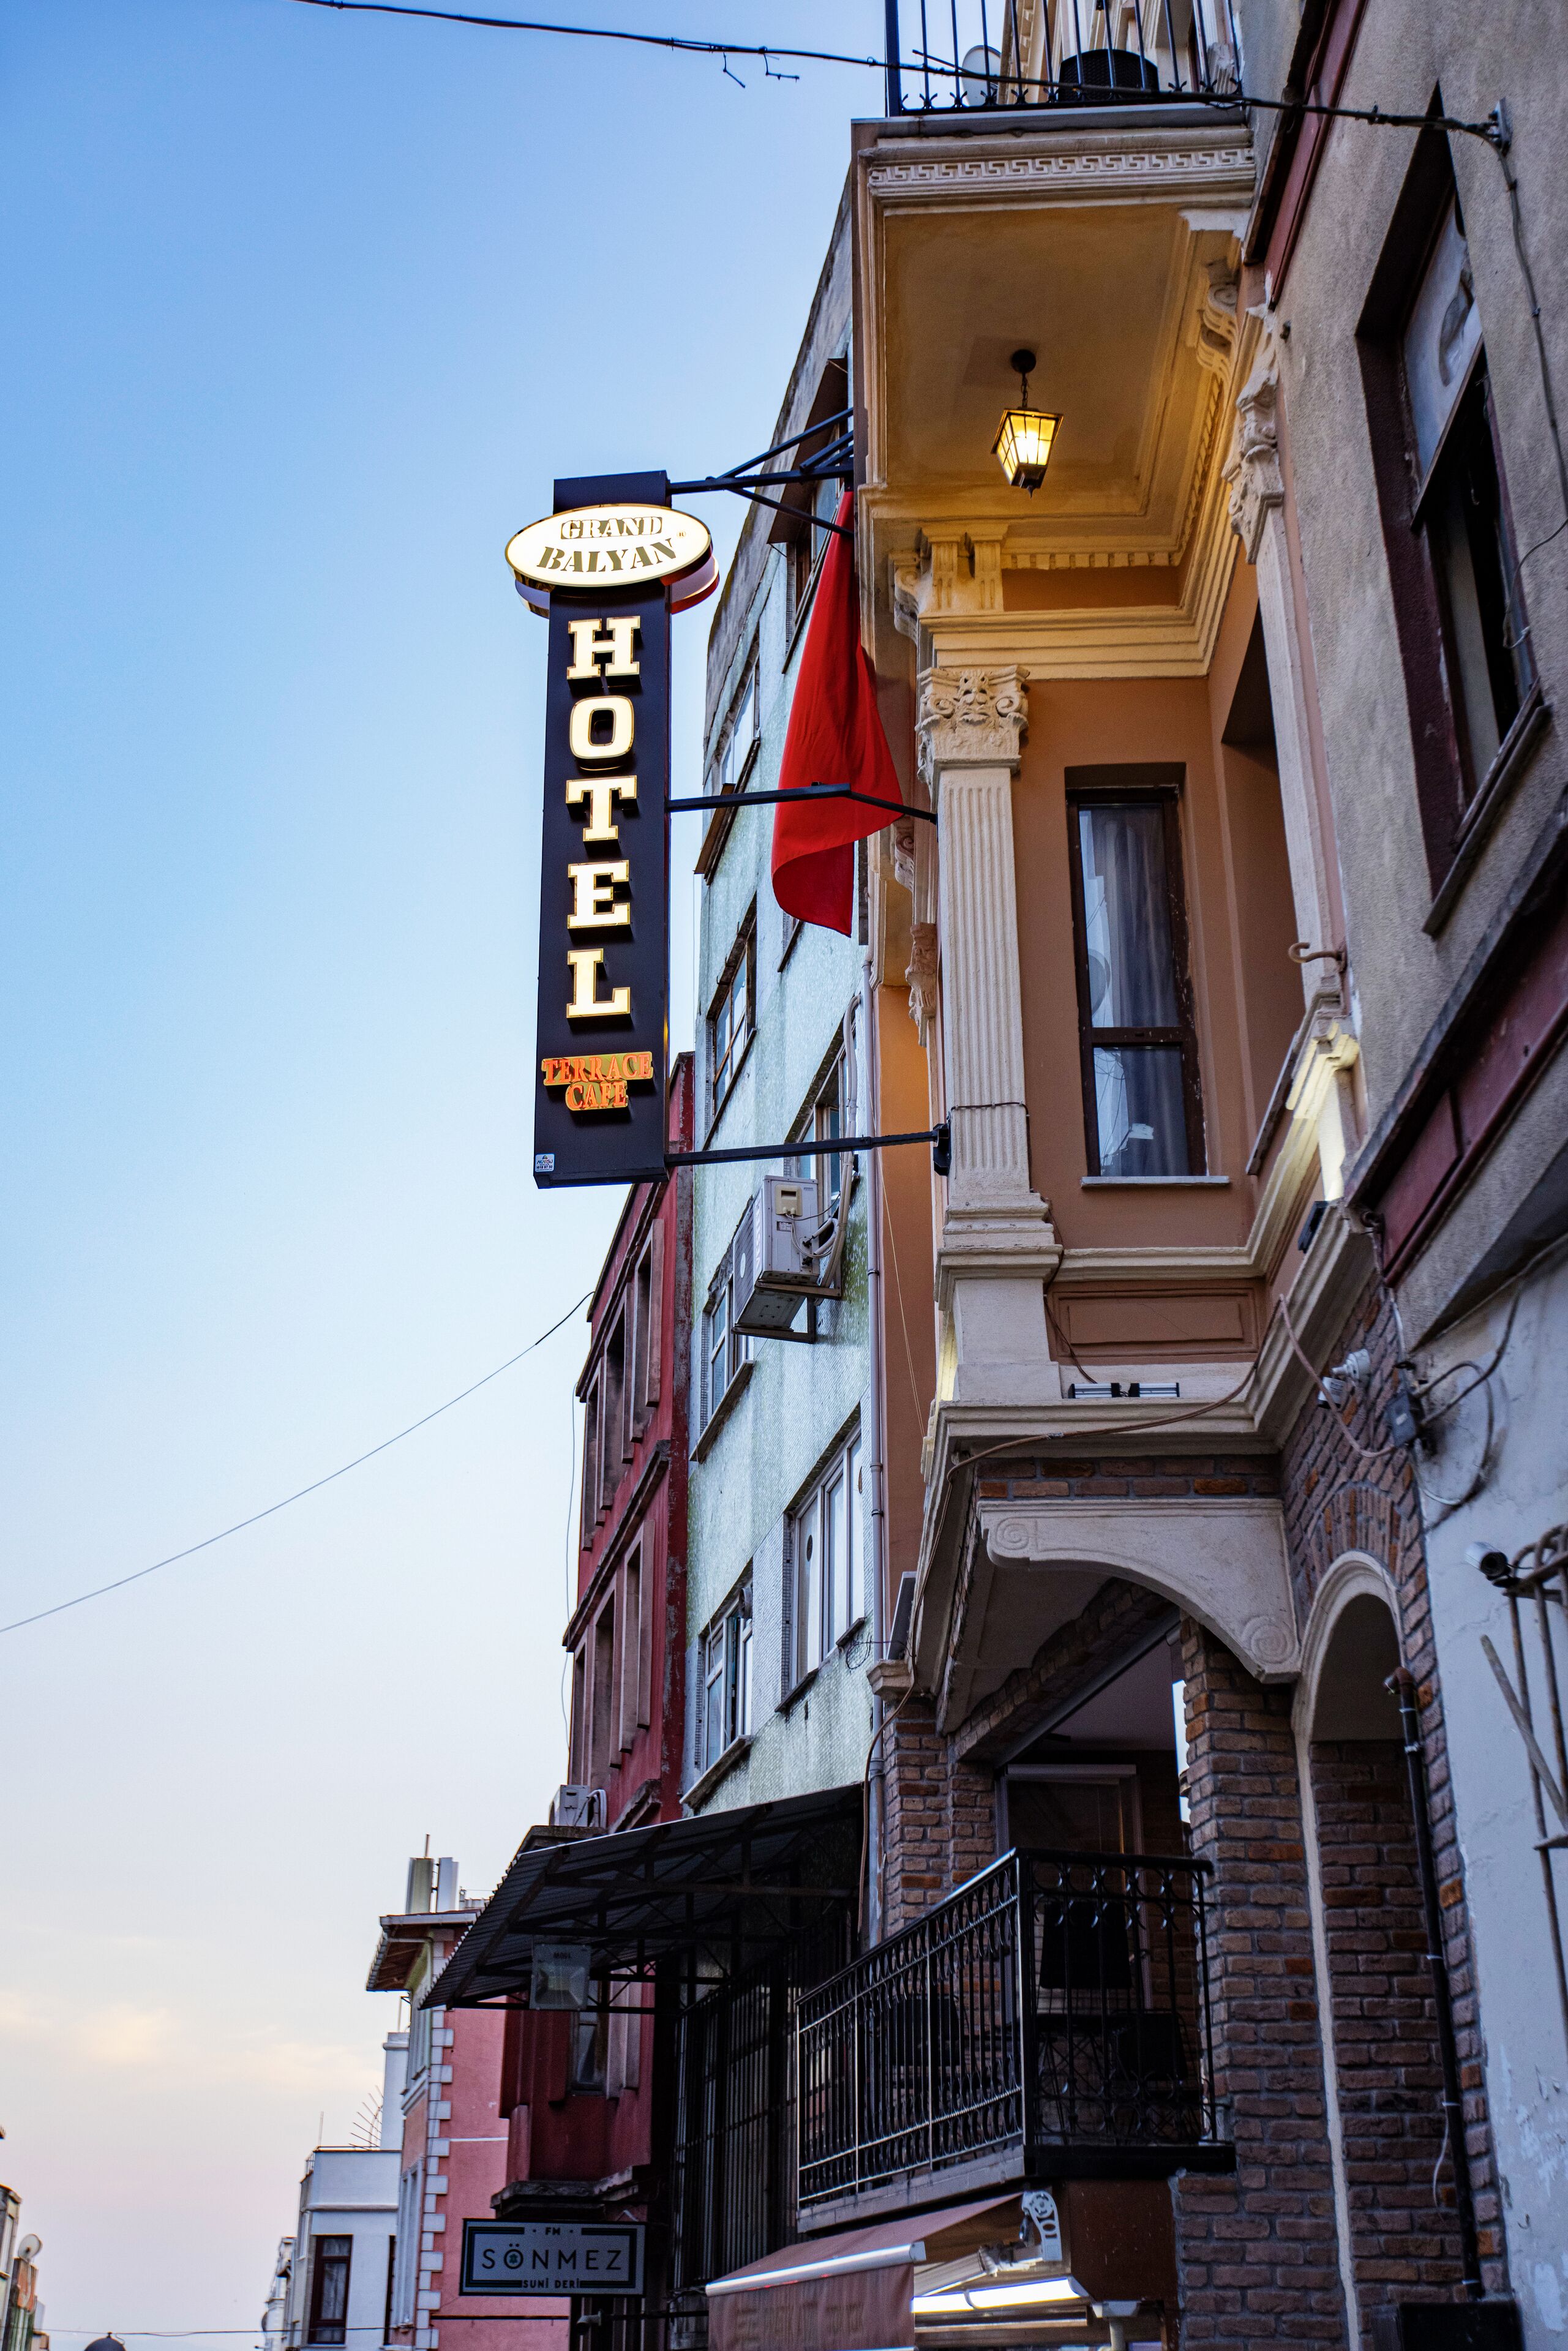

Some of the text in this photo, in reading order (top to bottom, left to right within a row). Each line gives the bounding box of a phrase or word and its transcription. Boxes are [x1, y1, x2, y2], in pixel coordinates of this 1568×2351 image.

[561, 516, 662, 540] GRAND
[536, 538, 677, 572] BALYAN
[566, 615, 640, 1018] HOTEL
[543, 1053, 651, 1084] TERRACE
[567, 1080, 627, 1109] CAFE
[545, 2227, 561, 2235] FM
[481, 2243, 622, 2270] SÖNMEZ
